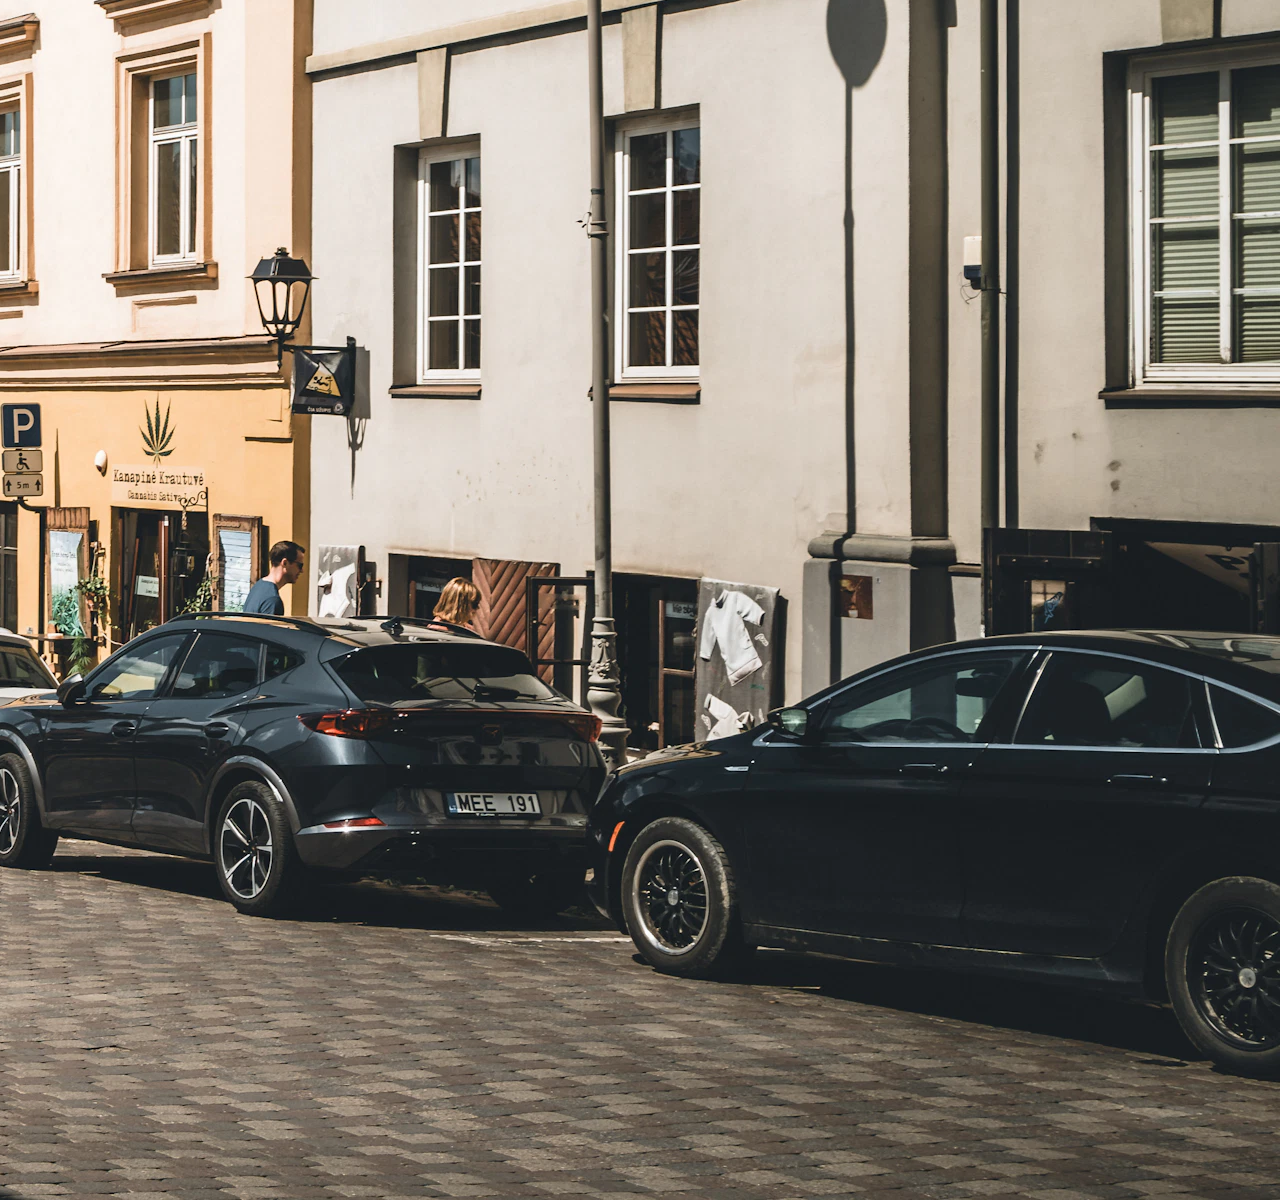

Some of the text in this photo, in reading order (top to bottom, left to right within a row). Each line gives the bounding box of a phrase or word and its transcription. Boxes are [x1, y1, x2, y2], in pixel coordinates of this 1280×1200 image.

[13, 408, 35, 443] P
[113, 469, 205, 487] Kanapinė Krautuvė
[127, 489, 158, 501] Cannabis
[456, 794, 536, 813] MEE 191
